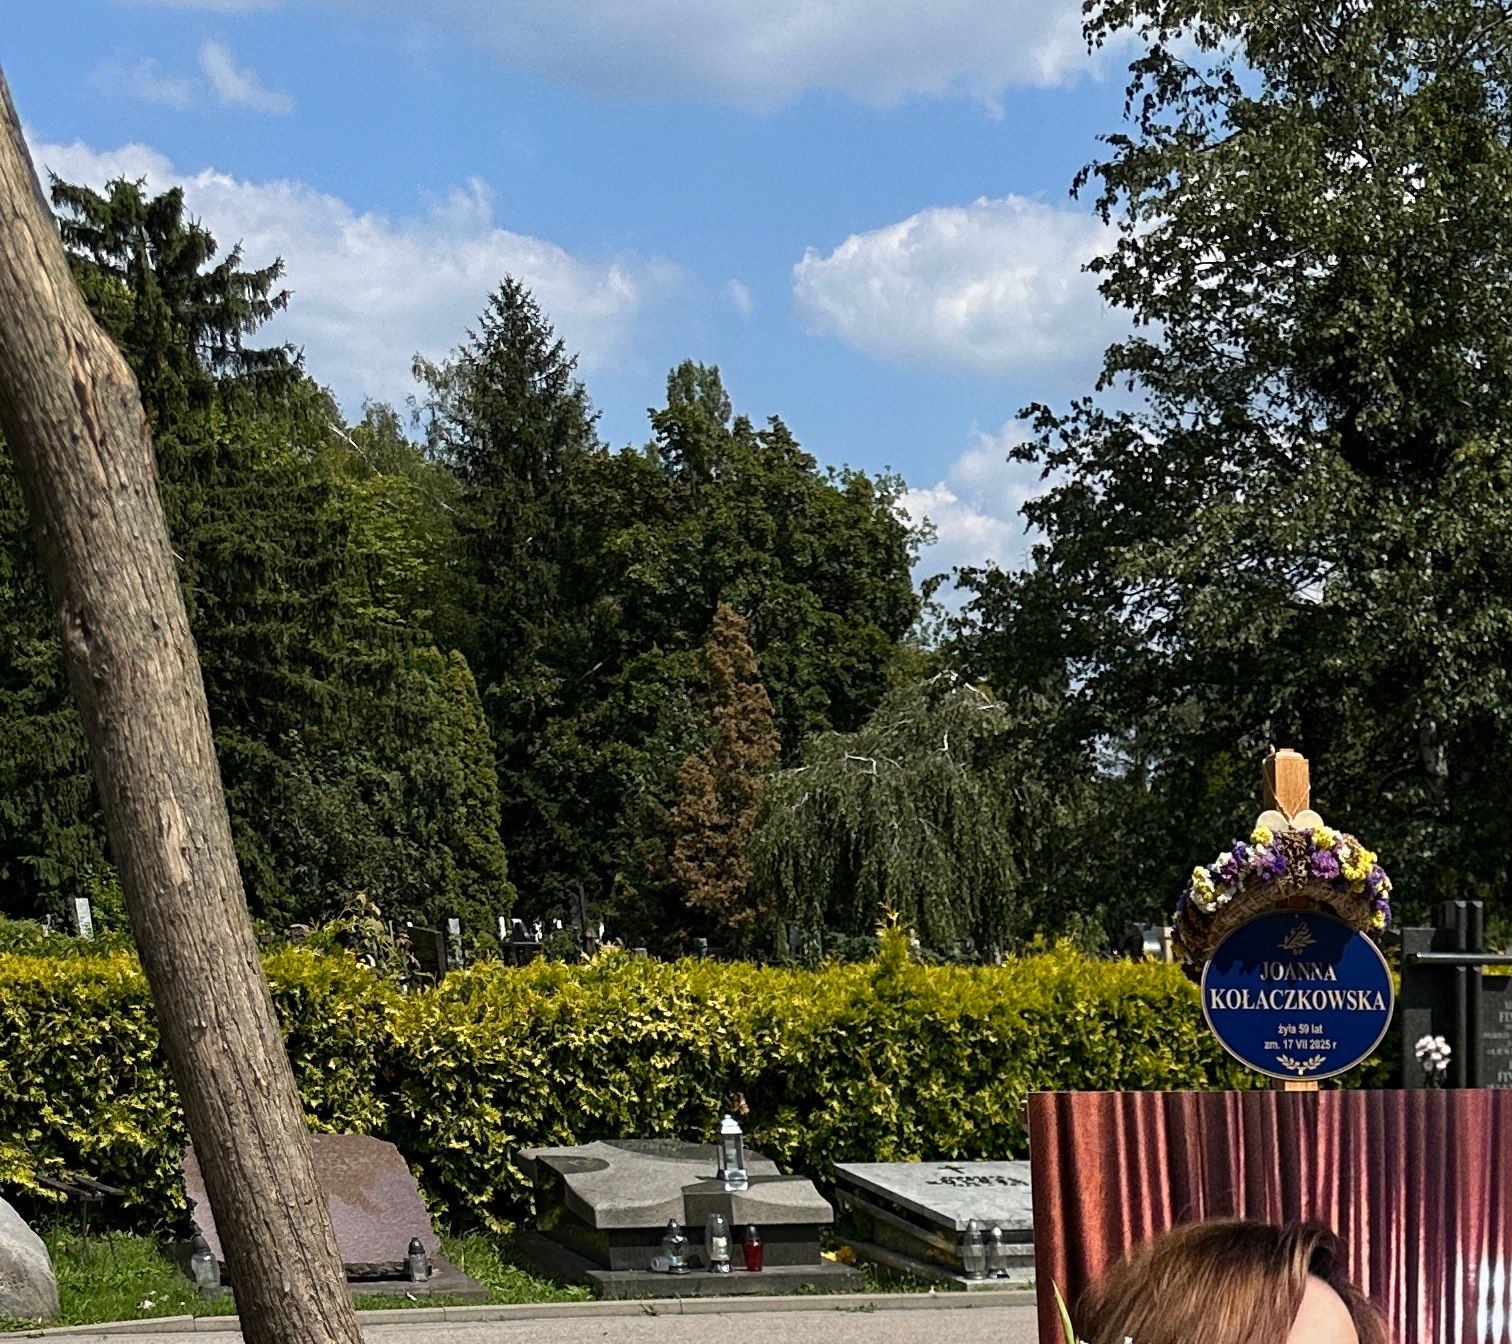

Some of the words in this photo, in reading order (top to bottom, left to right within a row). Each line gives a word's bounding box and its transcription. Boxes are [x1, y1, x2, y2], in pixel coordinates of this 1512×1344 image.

[1259, 961, 1337, 982] JOANNA
[1209, 988, 1386, 1011] KOŁACZKOWSKA
[1311, 1024, 1323, 1034] lat
[1283, 1039, 1293, 1049] 17
[1310, 1039, 1331, 1049] 2025
